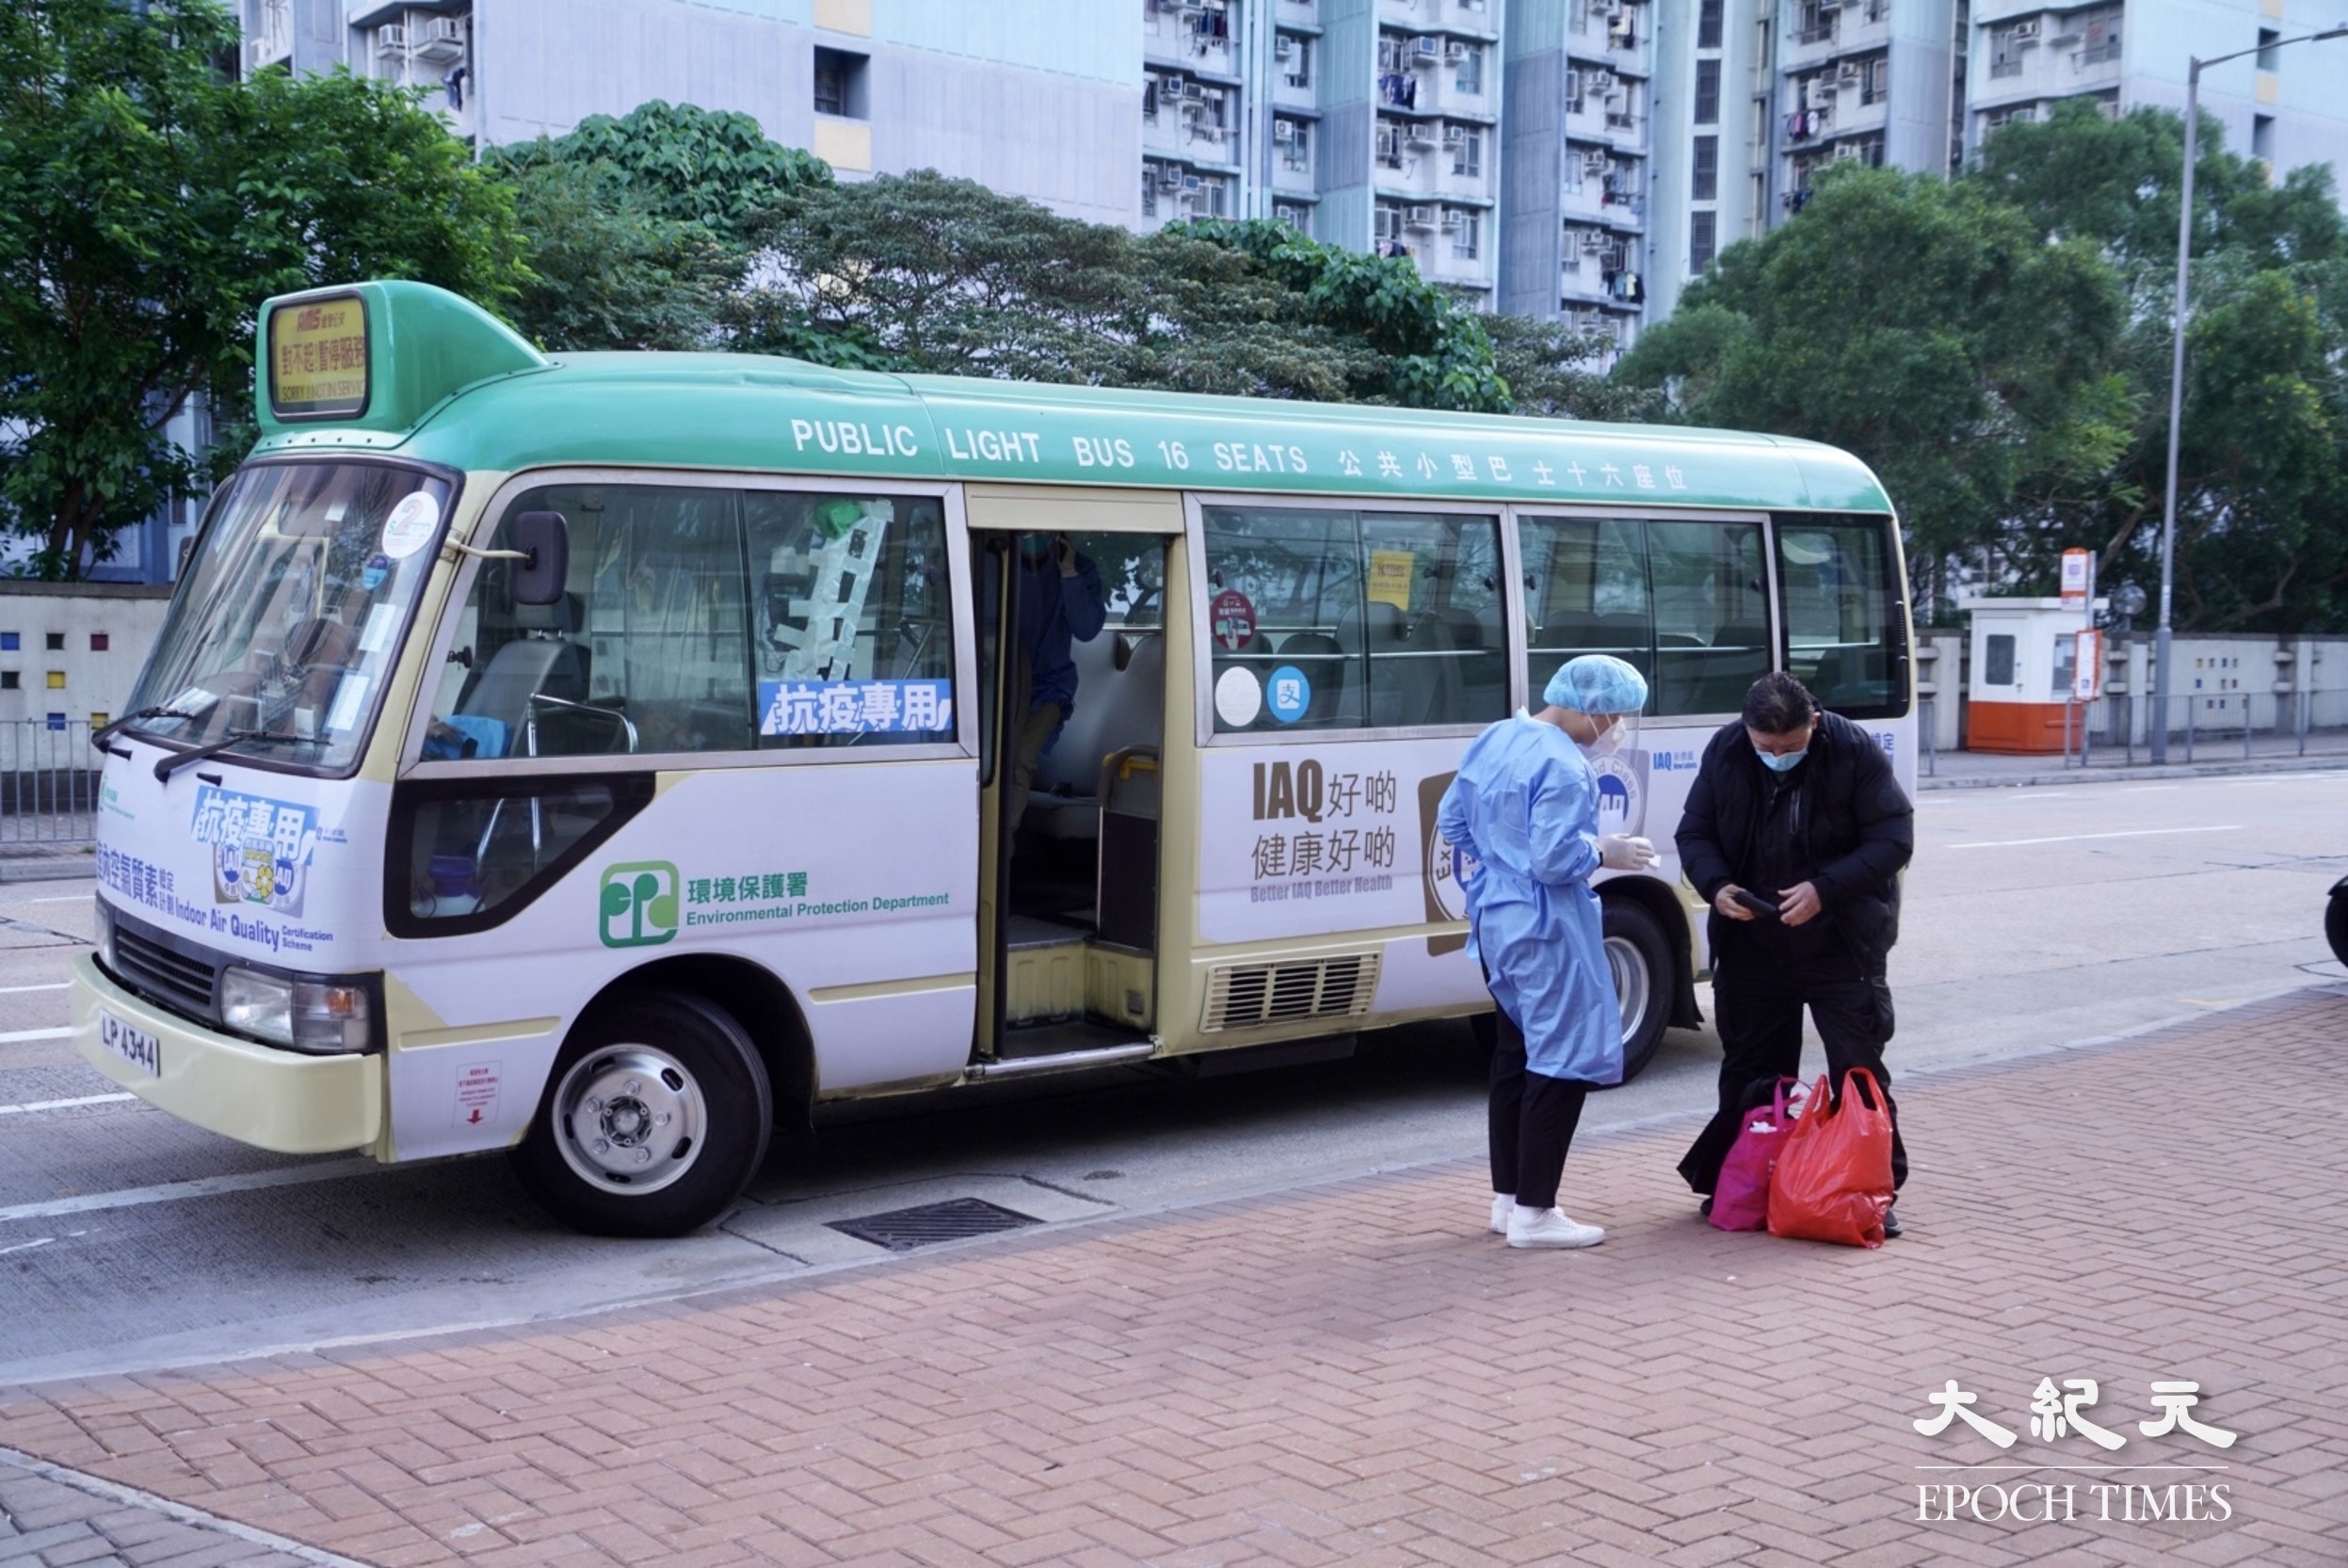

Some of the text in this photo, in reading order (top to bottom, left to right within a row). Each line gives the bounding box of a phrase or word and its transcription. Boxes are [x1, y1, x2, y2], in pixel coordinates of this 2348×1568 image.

[791, 419, 1308, 473] PUBLIC LIGHT BUS 16 SEATS
[775, 682, 937, 733] 抗疫專用
[1652, 751, 1672, 771] IAQ
[1252, 759, 1324, 824] IAQ
[1327, 770, 1396, 818] 好啲
[197, 789, 307, 861] 抗疫專用
[1251, 825, 1395, 881] 健康好啲
[686, 892, 949, 926] Environmental Protection Department
[687, 872, 808, 904] 環境保護署
[1251, 874, 1393, 904] Better IAQ Better Health
[175, 896, 280, 952] Indoor Air Quality
[282, 925, 333, 941] Certification
[282, 937, 314, 952] Scheme
[103, 1015, 153, 1070] LP 4344
